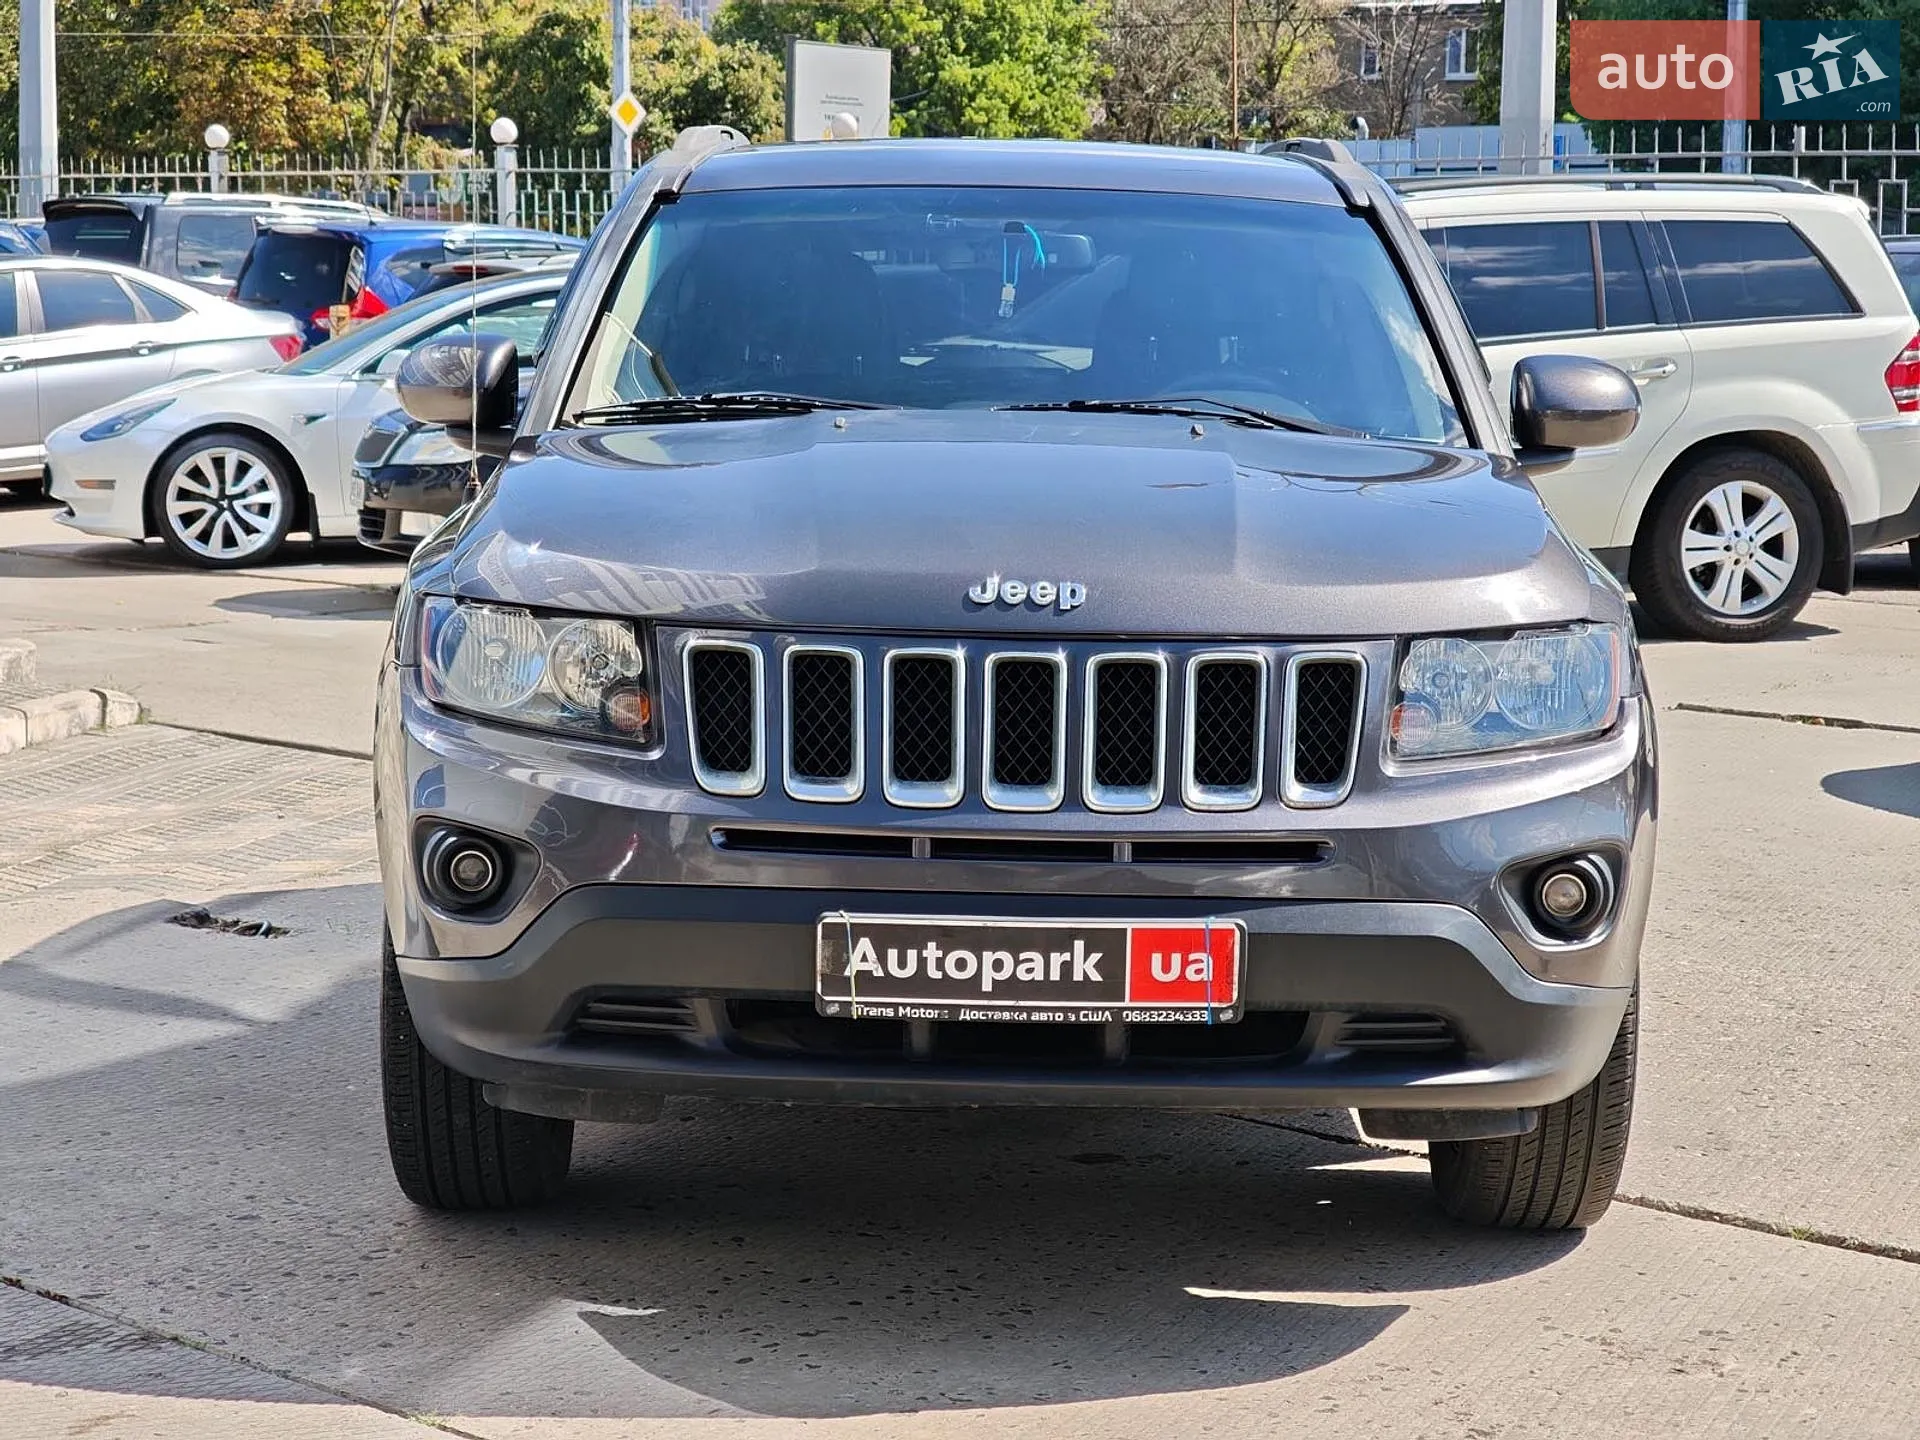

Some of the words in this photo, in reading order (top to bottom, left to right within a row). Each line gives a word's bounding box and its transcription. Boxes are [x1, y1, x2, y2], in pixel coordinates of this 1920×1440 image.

[968, 573, 1087, 610] Jeep
[843, 936, 1104, 992] Autopark
[1150, 951, 1215, 983] ua
[855, 1004, 895, 1017] Trans
[958, 1007, 1028, 1021] Доставка
[1030, 1011, 1064, 1022] авто
[1079, 1010, 1113, 1022] США
[1122, 1010, 1209, 1022] 0683234333
